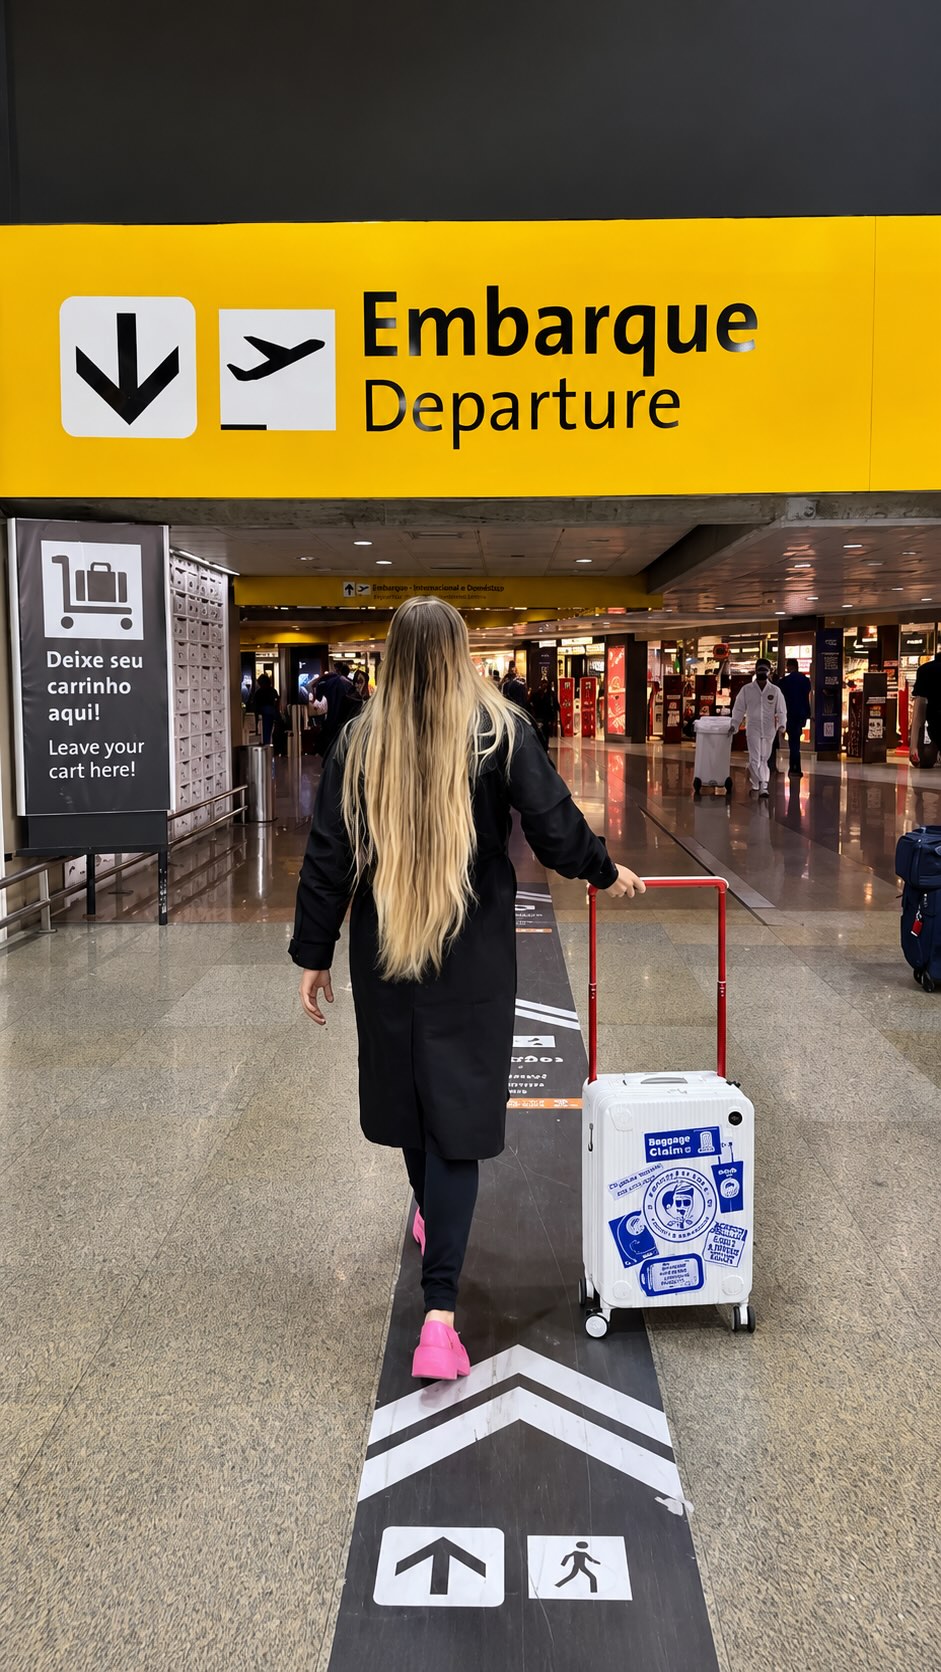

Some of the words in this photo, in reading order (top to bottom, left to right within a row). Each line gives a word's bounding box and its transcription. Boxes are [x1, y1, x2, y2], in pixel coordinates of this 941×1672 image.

[363, 285, 758, 377] Embarque
[365, 378, 681, 450] Departure
[372, 584, 408, 593] Embarque
[46, 650, 104, 668] Deixe
[110, 655, 143, 668] seu
[47, 677, 131, 694] carrinho
[48, 703, 100, 726] aqui!
[49, 740, 100, 756] Leave
[104, 741, 145, 759] your
[49, 763, 85, 779] cart
[90, 761, 136, 778] here!
[648, 1135, 691, 1147] Baggage
[649, 1147, 683, 1156] Claim
